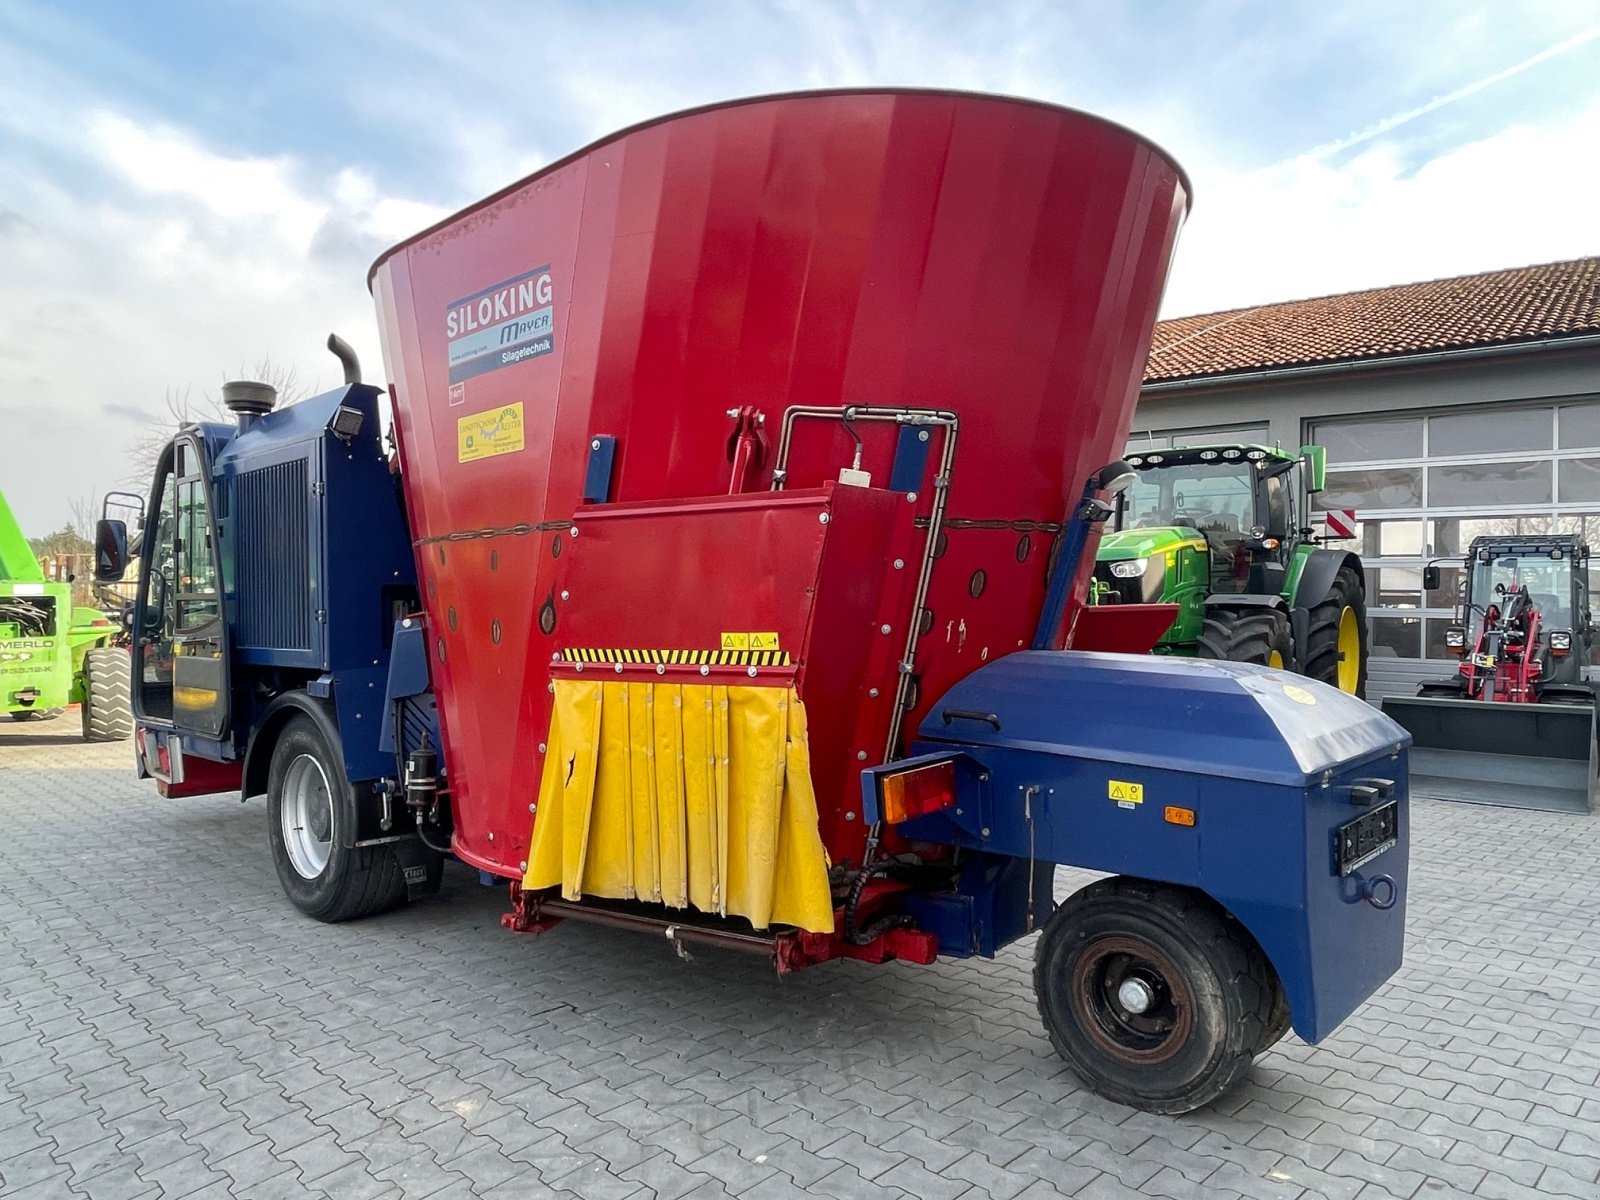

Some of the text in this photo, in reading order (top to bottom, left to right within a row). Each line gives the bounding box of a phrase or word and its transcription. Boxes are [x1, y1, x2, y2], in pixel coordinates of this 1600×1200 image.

[446, 274, 552, 338] SILOKING
[500, 315, 549, 345] MAYER
[502, 339, 551, 364] Silagetechnik
[0, 640, 54, 649] MERLO
